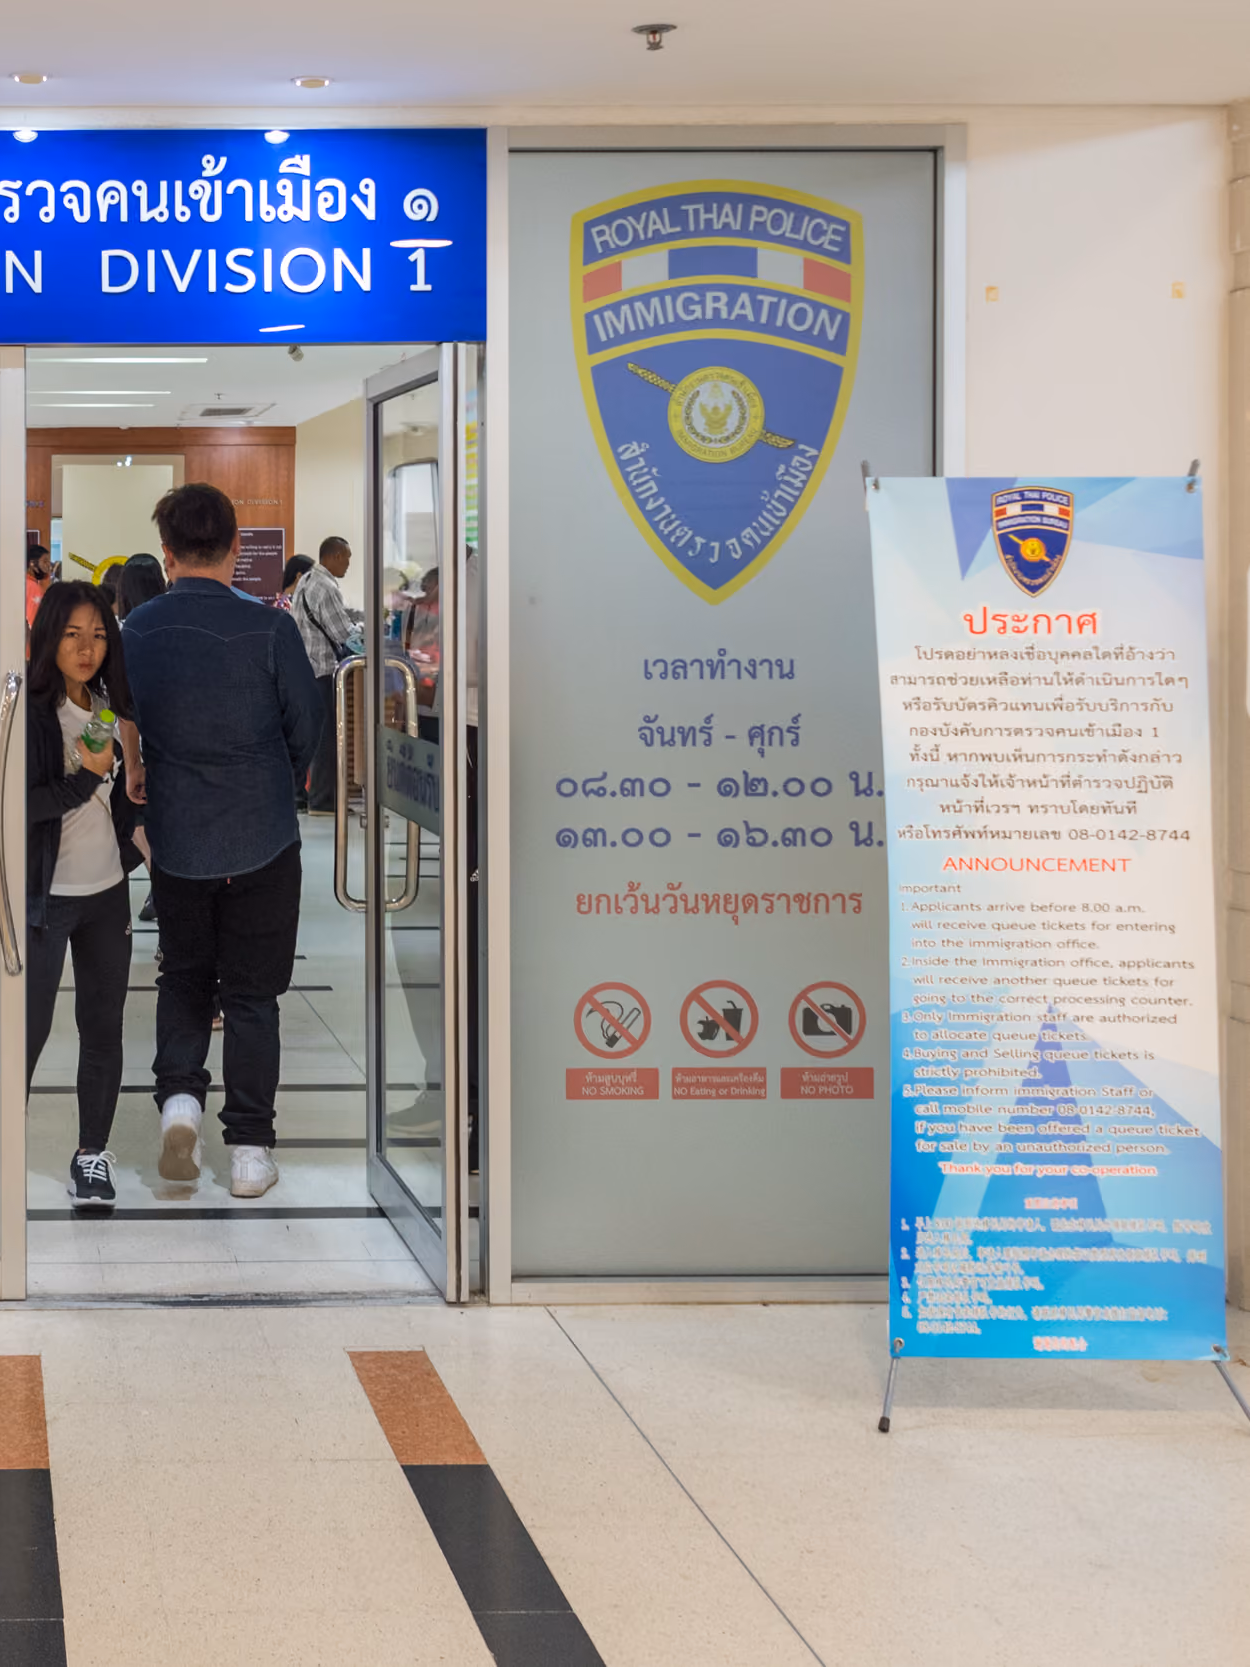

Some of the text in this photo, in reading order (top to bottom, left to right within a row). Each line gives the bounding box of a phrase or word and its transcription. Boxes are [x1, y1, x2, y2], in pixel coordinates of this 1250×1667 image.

[402, 186, 440, 223] ๑
[590, 202, 847, 253] ROYAL THAI POLICE
[100, 246, 372, 296] DIVISION
[407, 249, 433, 292] 1
[592, 290, 844, 342] IMMIGRATION
[963, 605, 1098, 636] ประกาศ
[643, 648, 796, 681] เวลาทำงาน
[638, 713, 714, 748] จันทร์
[747, 713, 802, 758] ศุกร์
[555, 771, 673, 798] ๐๘.๓๐
[716, 769, 833, 799] ๑๒.๐๐
[848, 770, 885, 798] น.
[1028, 799, 1137, 816] ทราบโดยทันที
[555, 826, 673, 848] ๑๓.๐๐
[716, 820, 833, 848] ๑๖.๓๐
[848, 820, 885, 848] น.
[1068, 828, 1190, 841] 08-0142-8744
[943, 857, 1132, 872] ANNOUNCEMENT
[576, 881, 863, 925] ยกเว้นวันหยุดราชการ
[911, 919, 1176, 935] will receive queue tickets for entering
[913, 974, 1175, 989] will receive another queue tickets for
[913, 993, 947, 1006] going
[951, 994, 966, 1004] to
[970, 993, 993, 1004] the
[998, 993, 1048, 1004] correct
[1053, 994, 1125, 1006] processing
[581, 1086, 644, 1096] NO SMOKING
[674, 1086, 766, 1098] NO Eating or Drinking
[801, 1085, 854, 1096] NO PHOTO
[941, 1163, 1157, 1176] Thank you for your co-operation
